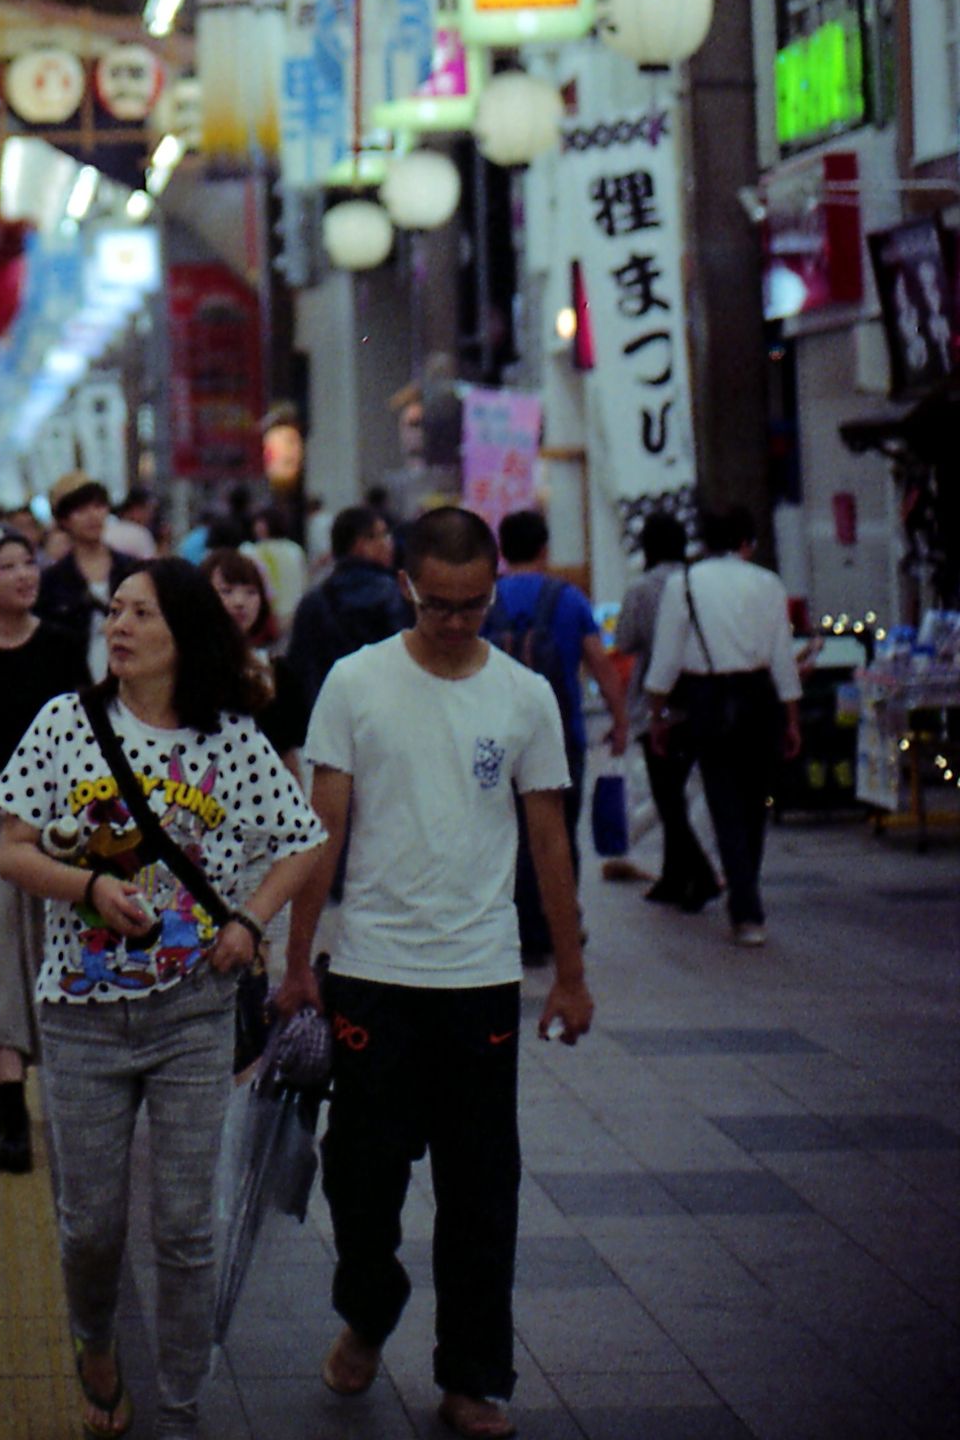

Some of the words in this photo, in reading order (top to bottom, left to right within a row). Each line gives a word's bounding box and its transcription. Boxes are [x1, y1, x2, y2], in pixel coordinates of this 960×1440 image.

[591, 169, 674, 453] 狸まつり
[67, 772, 160, 813] LOOY
[163, 780, 226, 829] TUNES
